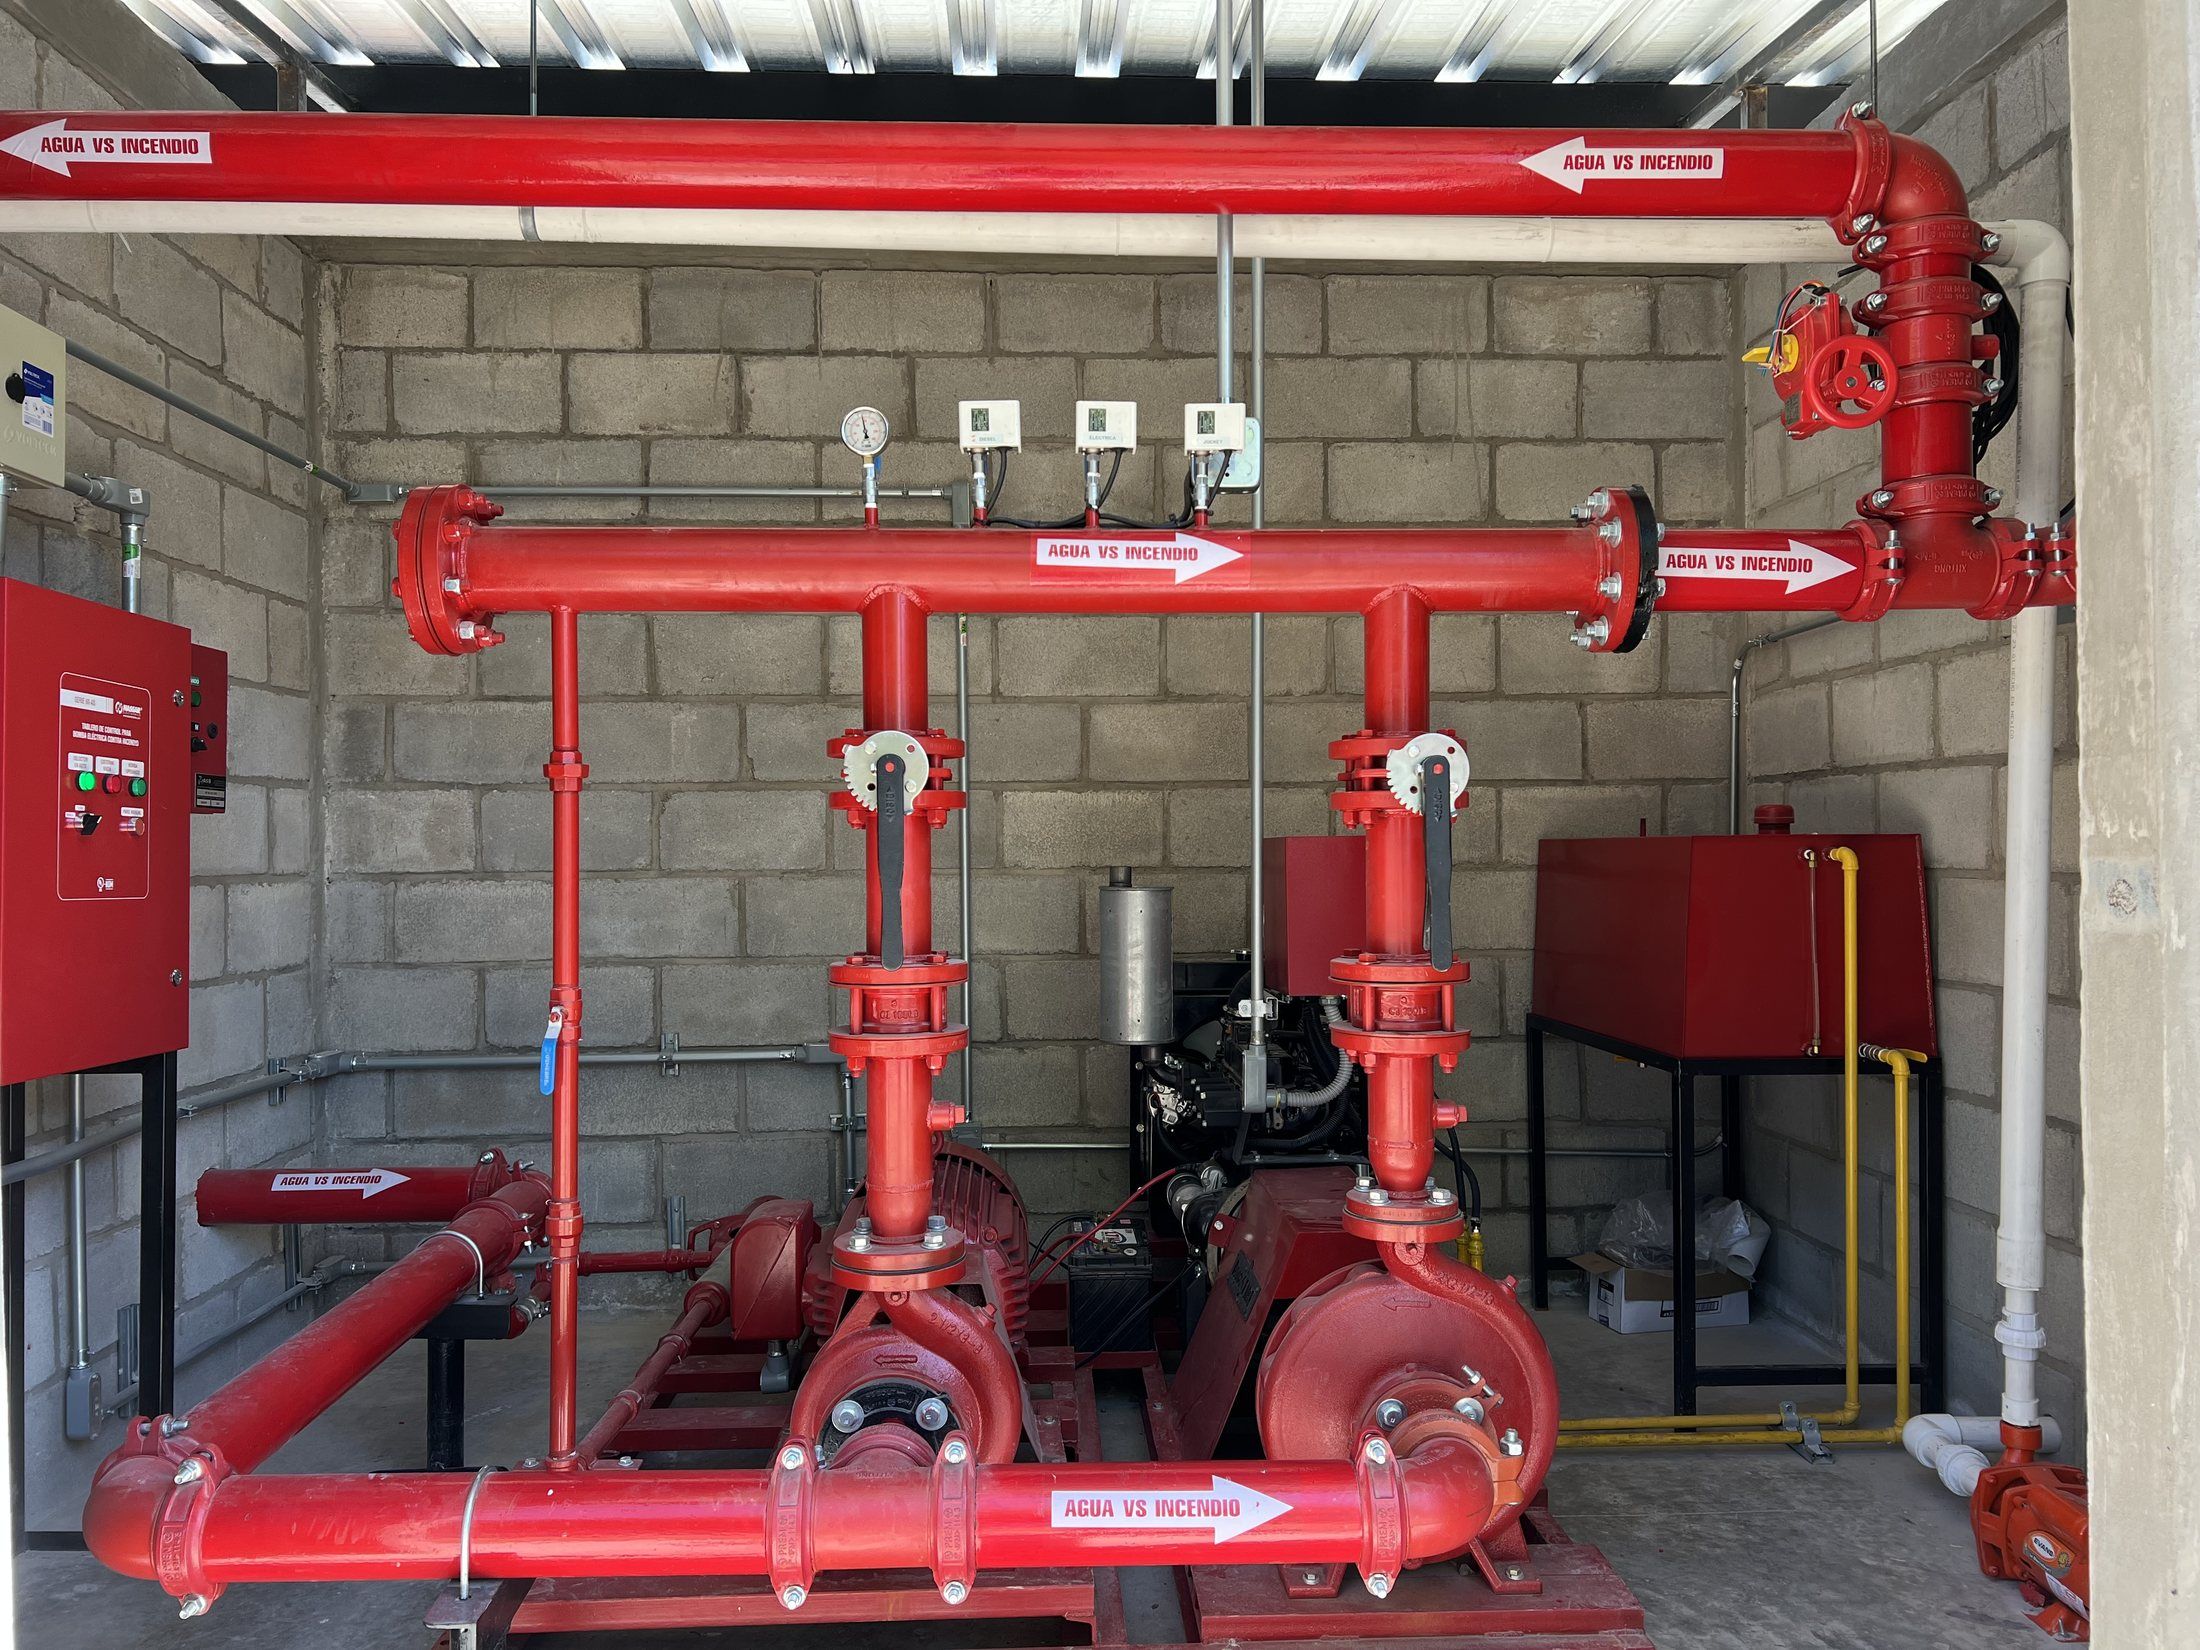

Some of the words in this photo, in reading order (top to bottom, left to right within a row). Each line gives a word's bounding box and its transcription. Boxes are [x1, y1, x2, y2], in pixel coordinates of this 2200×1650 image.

[41, 136, 85, 153] AGUA
[92, 137, 115, 154] VS
[121, 138, 199, 155] INCENDIO
[1563, 154, 1605, 170] AGUA
[1612, 154, 1634, 170] VS
[1639, 154, 1713, 171] INCENDIO
[1047, 543, 1091, 559] AGUA
[1098, 545, 1119, 560] VS
[1125, 546, 1199, 562] INCENDIO
[1665, 553, 1708, 570] AGUA
[1714, 554, 1735, 570] VS
[1741, 556, 1813, 573] INCENDIO
[280, 1176, 309, 1186] AGUA
[314, 1175, 328, 1186] VS
[331, 1175, 382, 1185] INCENDIO
[1064, 1498, 1114, 1518] AGUA
[1123, 1498, 1147, 1518] VS
[1155, 1498, 1241, 1518] INCENDIO
[2033, 1537, 2054, 1557] EVANS
